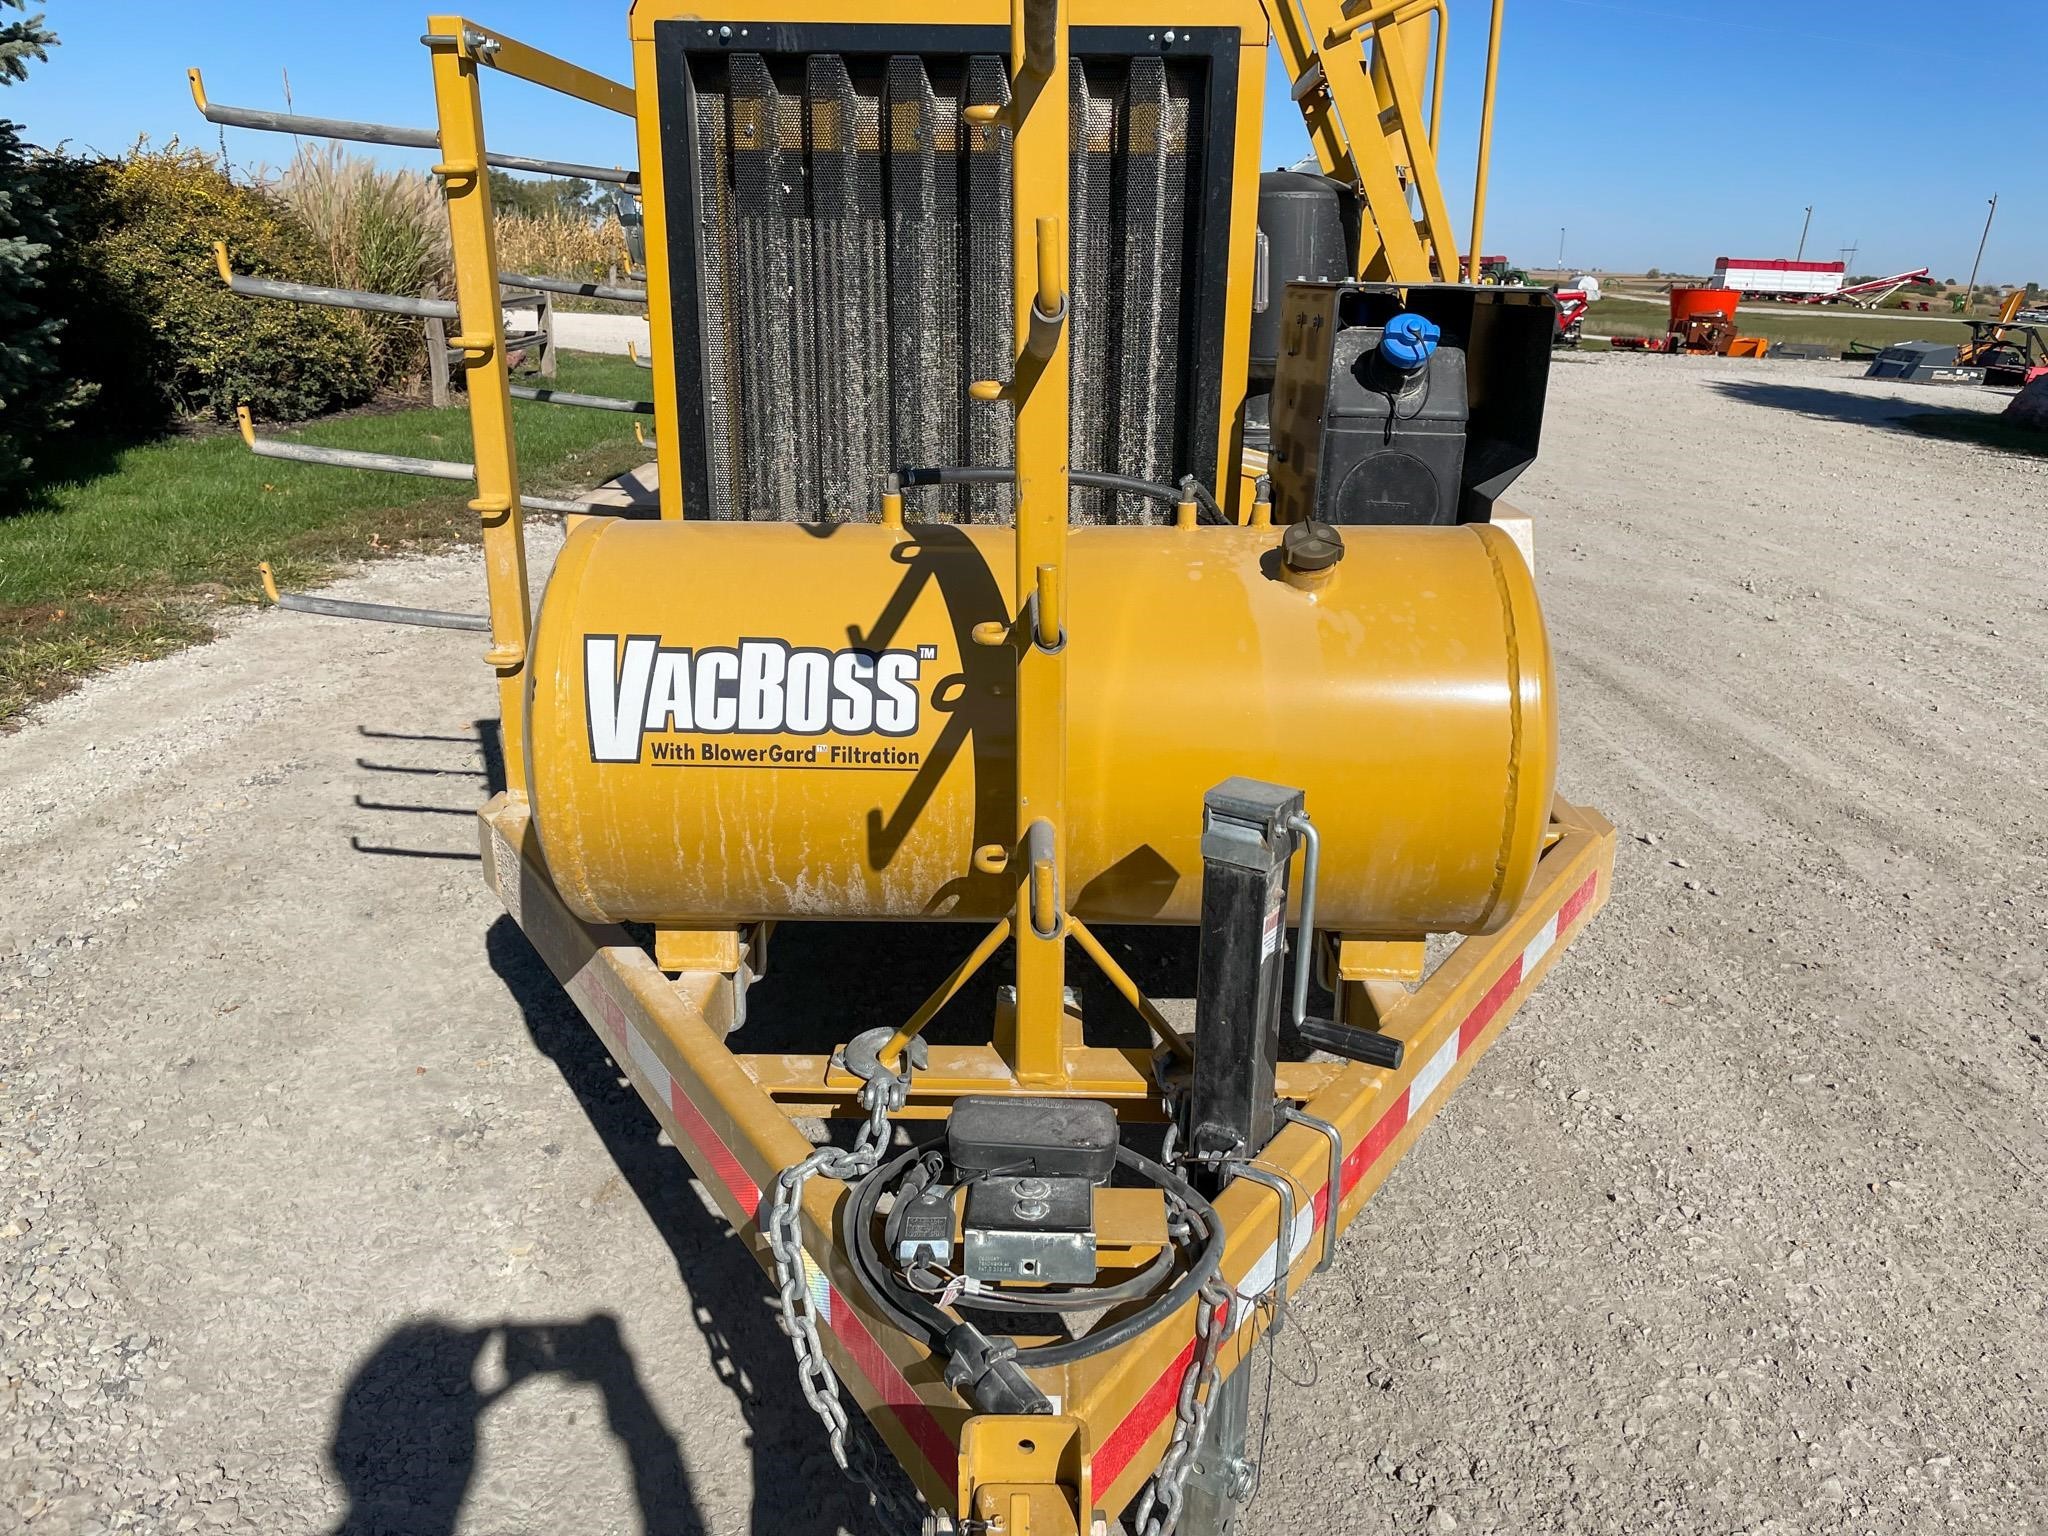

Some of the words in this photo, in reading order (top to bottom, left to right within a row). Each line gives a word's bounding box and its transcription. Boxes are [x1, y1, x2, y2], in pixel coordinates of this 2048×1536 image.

[651, 742, 695, 761] With
[701, 743, 816, 763] BlowerGard
[831, 746, 919, 764] Filtration
